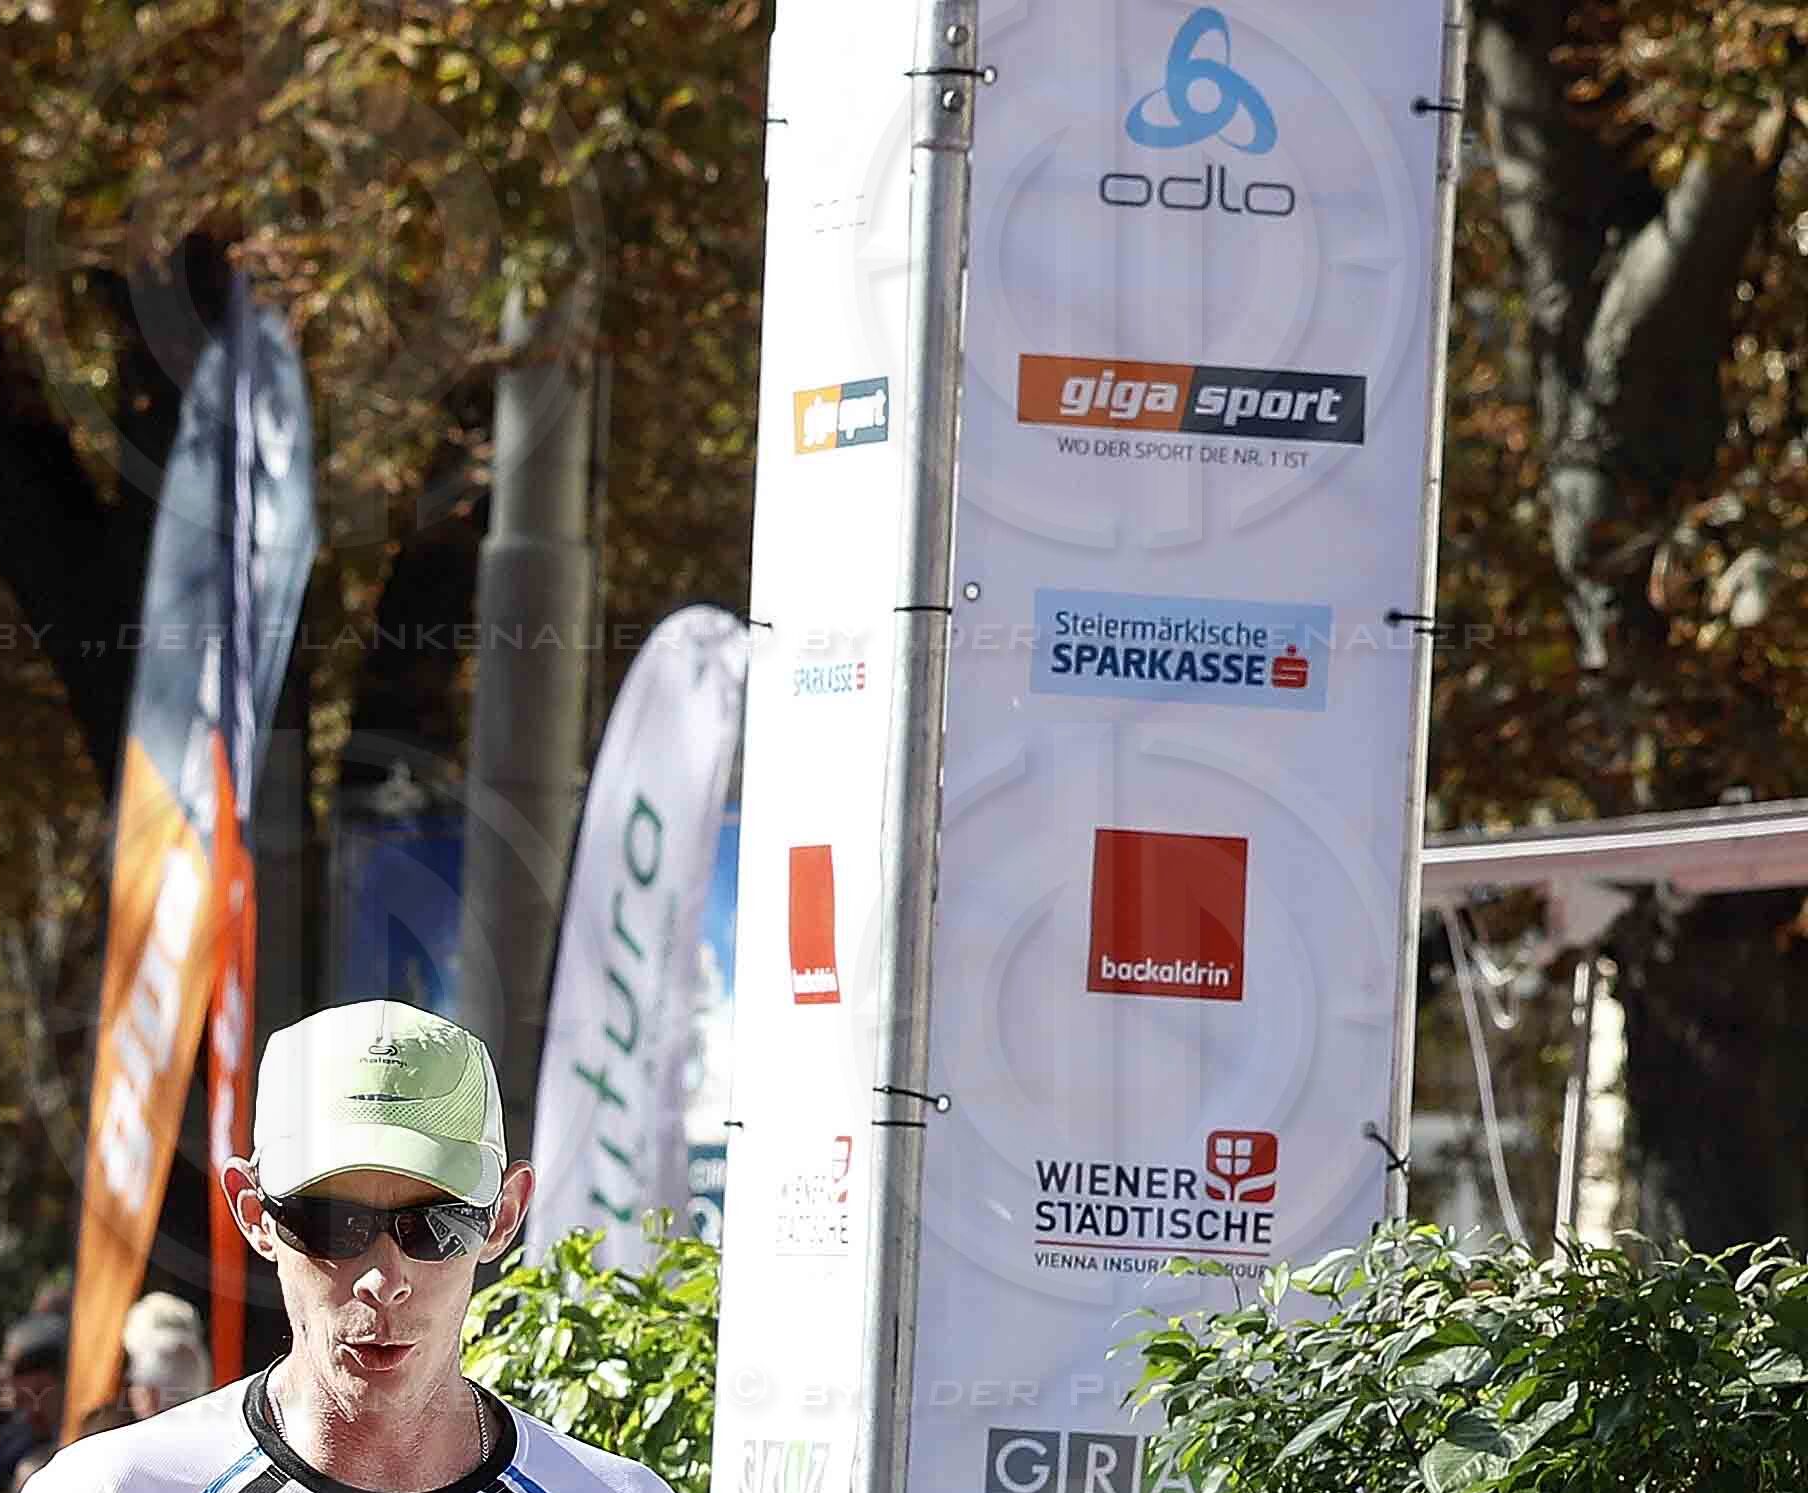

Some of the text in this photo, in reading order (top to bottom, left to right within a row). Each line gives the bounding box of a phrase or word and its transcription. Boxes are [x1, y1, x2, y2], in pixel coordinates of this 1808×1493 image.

[1099, 163, 1296, 217] odlo
[1060, 370, 1341, 427] giga sport
[1056, 437, 1309, 468] WO DER SPORT DIE NR. 1 IST
[1055, 611, 1267, 647] Steiermärkische
[1051, 643, 1266, 686] SPARKASSE
[1101, 956, 1230, 986] backaldrin
[1036, 1160, 1198, 1200] WIENER
[1035, 1200, 1275, 1244] STÄDTISCHE
[1034, 1252, 1097, 1271] VIENNA
